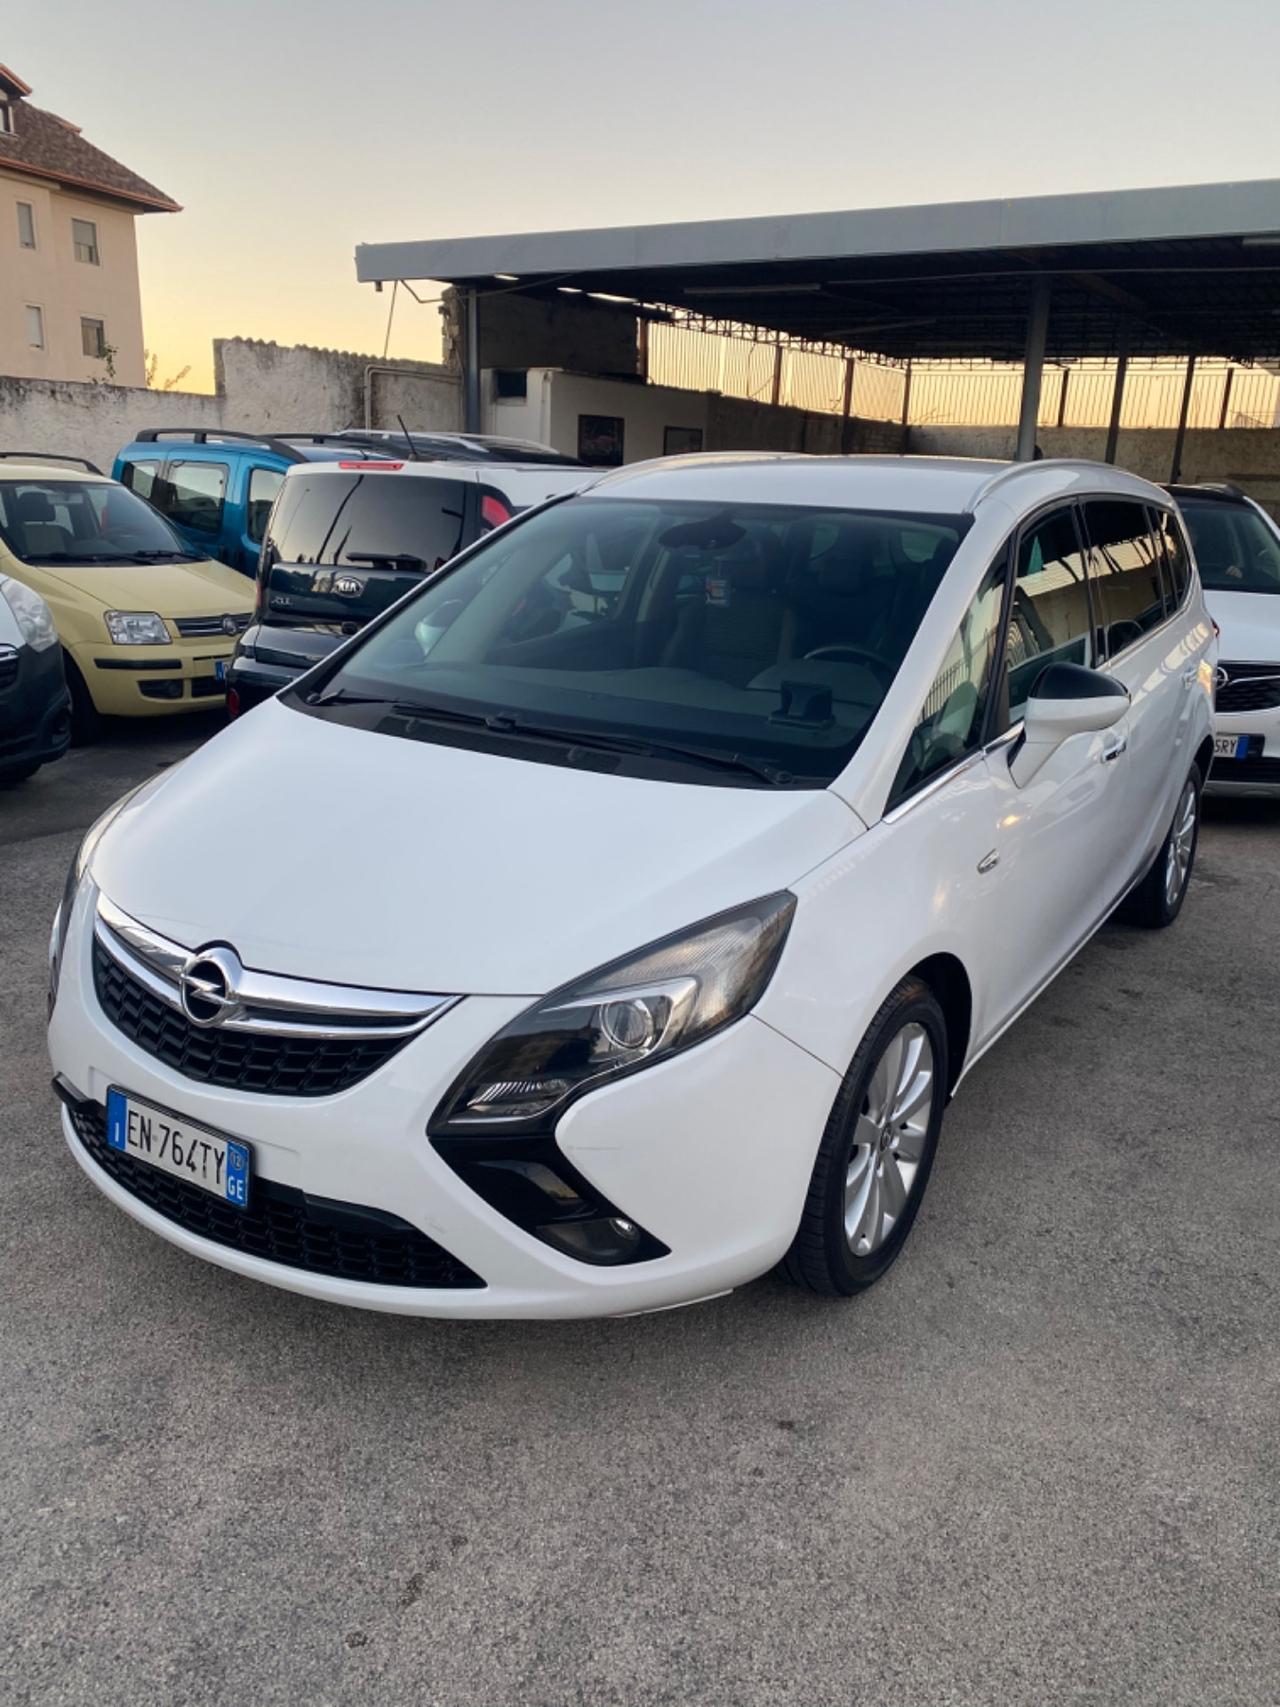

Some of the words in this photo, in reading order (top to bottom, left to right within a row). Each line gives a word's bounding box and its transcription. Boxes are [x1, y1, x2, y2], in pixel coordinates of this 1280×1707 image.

[338, 581, 358, 593] KIA
[127, 1109, 152, 1153] EN
[158, 1123, 225, 1185] 764TY
[228, 1175, 244, 1200] GE
